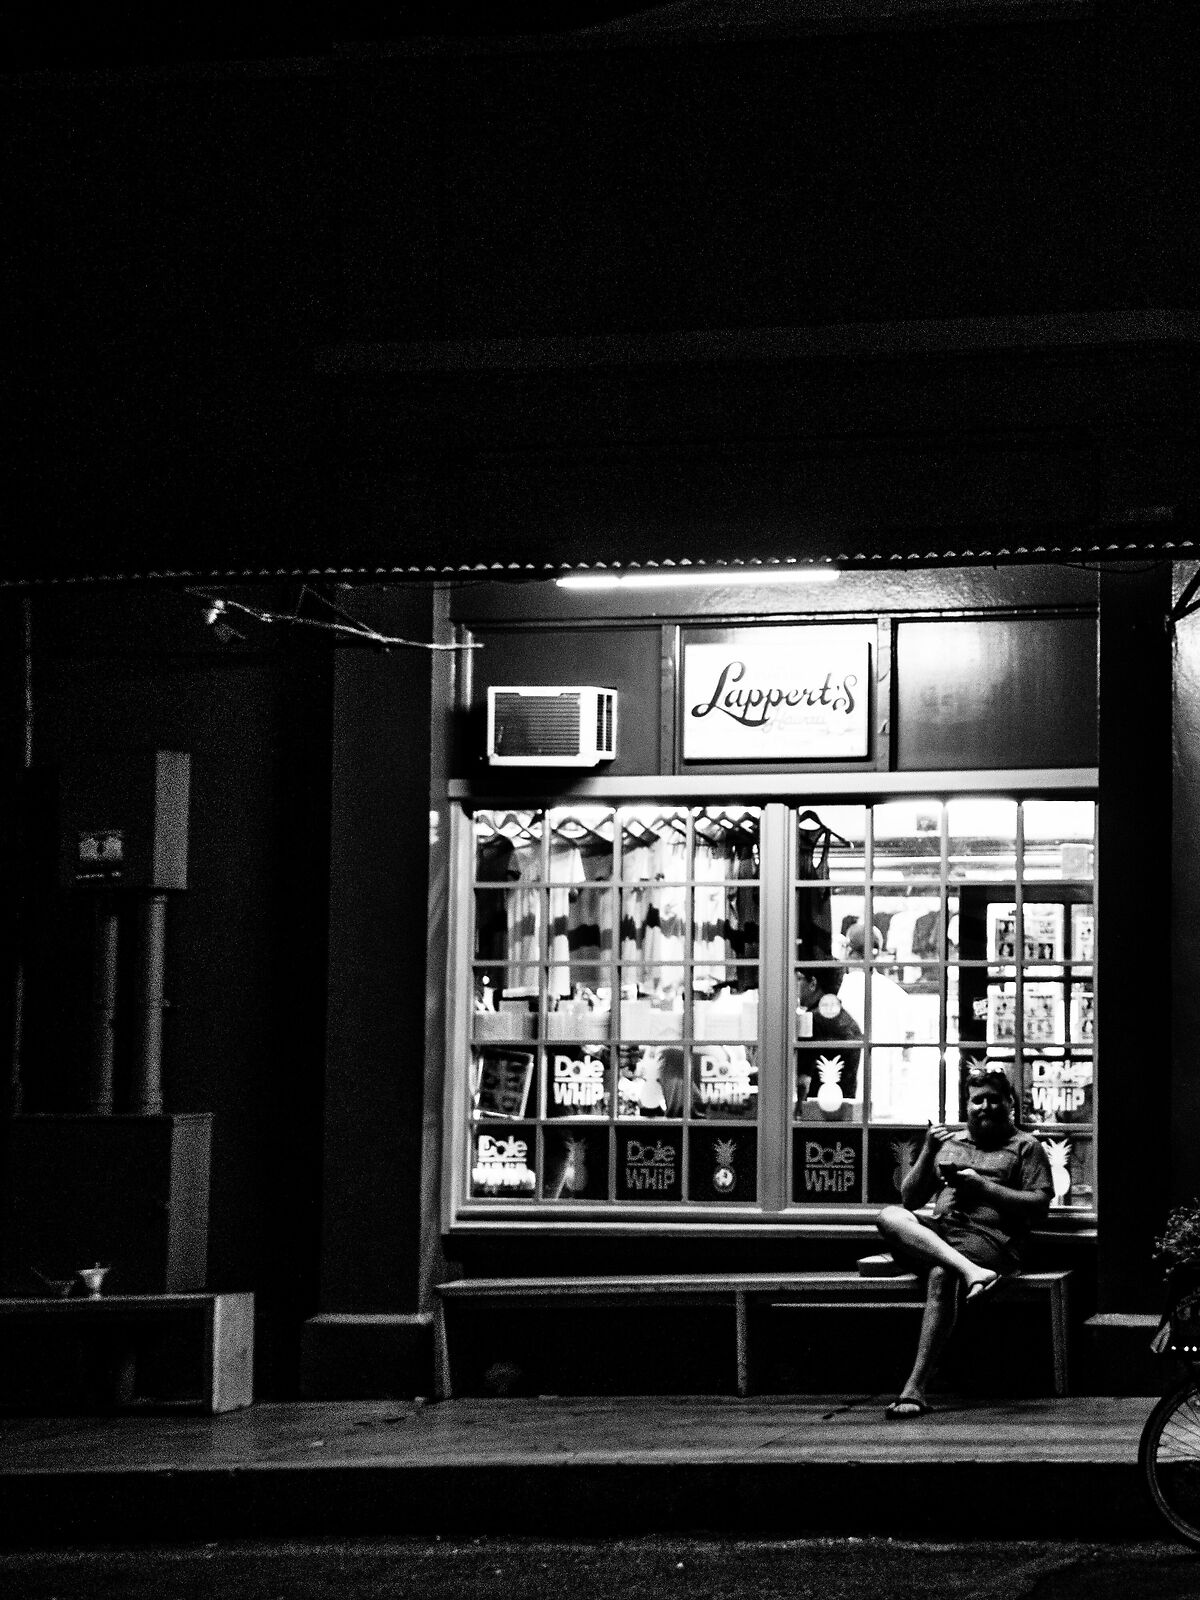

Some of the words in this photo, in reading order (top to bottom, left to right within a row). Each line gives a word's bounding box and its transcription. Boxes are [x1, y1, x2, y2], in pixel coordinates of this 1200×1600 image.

[555, 1055, 604, 1078] Dole
[626, 1139, 676, 1162] Dole
[804, 1140, 856, 1164] Dole
